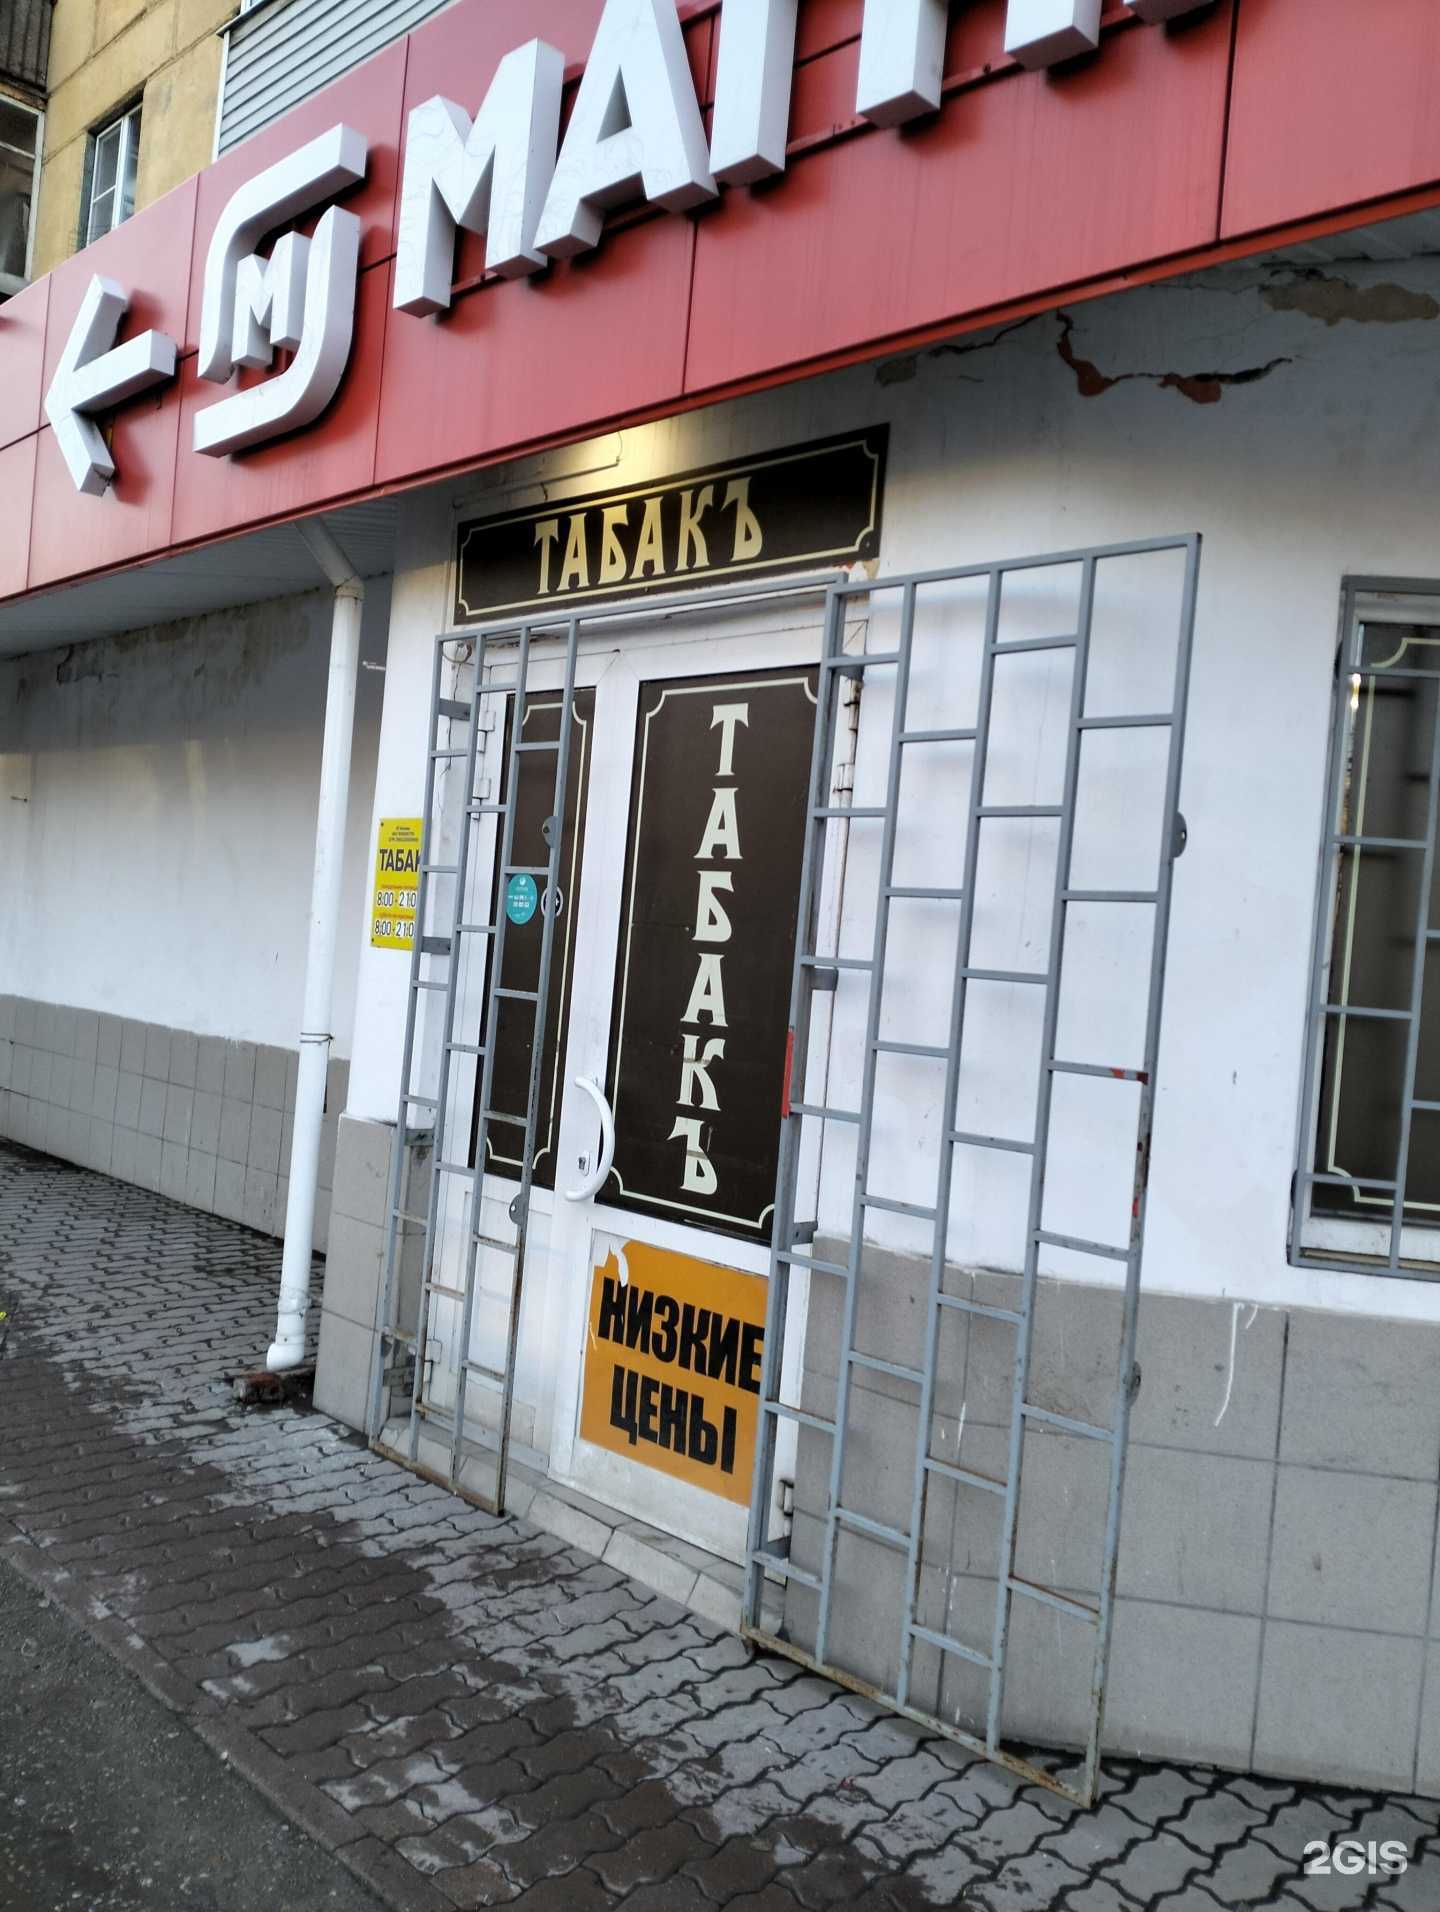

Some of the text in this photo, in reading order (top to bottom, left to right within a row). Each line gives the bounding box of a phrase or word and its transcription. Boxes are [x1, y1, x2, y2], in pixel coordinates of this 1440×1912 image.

[534, 476, 763, 594] ТАБАКЪ
[667, 703, 749, 1196] ТАБАКЪ
[598, 1277, 766, 1395] НИЗКИЕ
[610, 1364, 737, 1475] ЦЕНЫ
